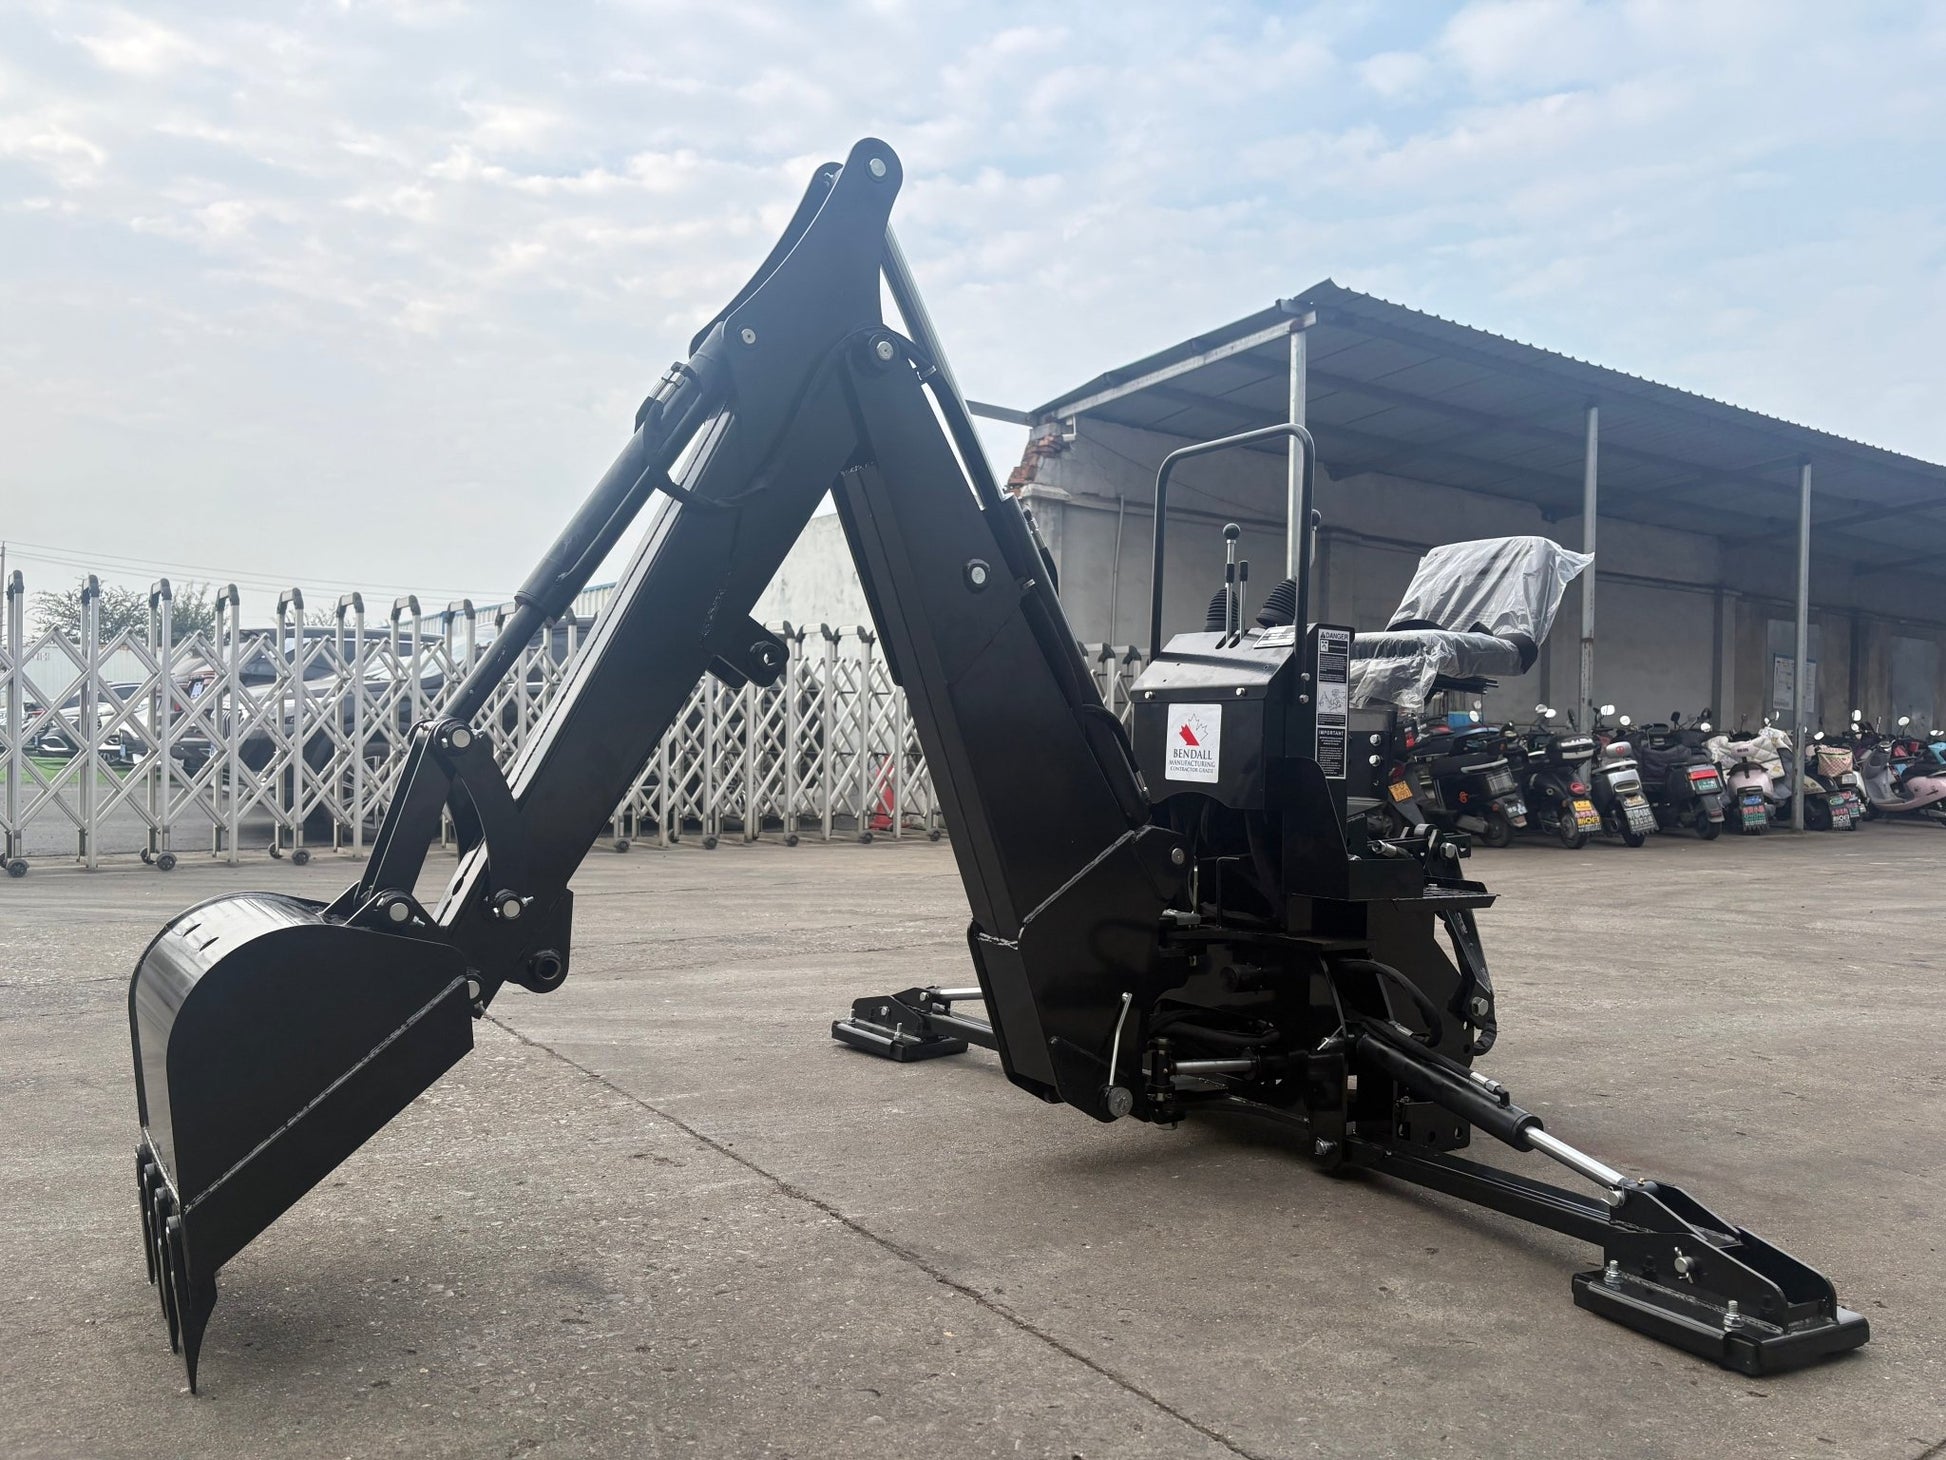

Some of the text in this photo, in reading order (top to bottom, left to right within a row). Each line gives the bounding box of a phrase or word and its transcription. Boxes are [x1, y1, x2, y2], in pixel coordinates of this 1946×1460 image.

[1326, 631, 1348, 640] DANGER
[1173, 748, 1212, 760] BENDALL
[1169, 759, 1215, 768] MANUFACTURING
